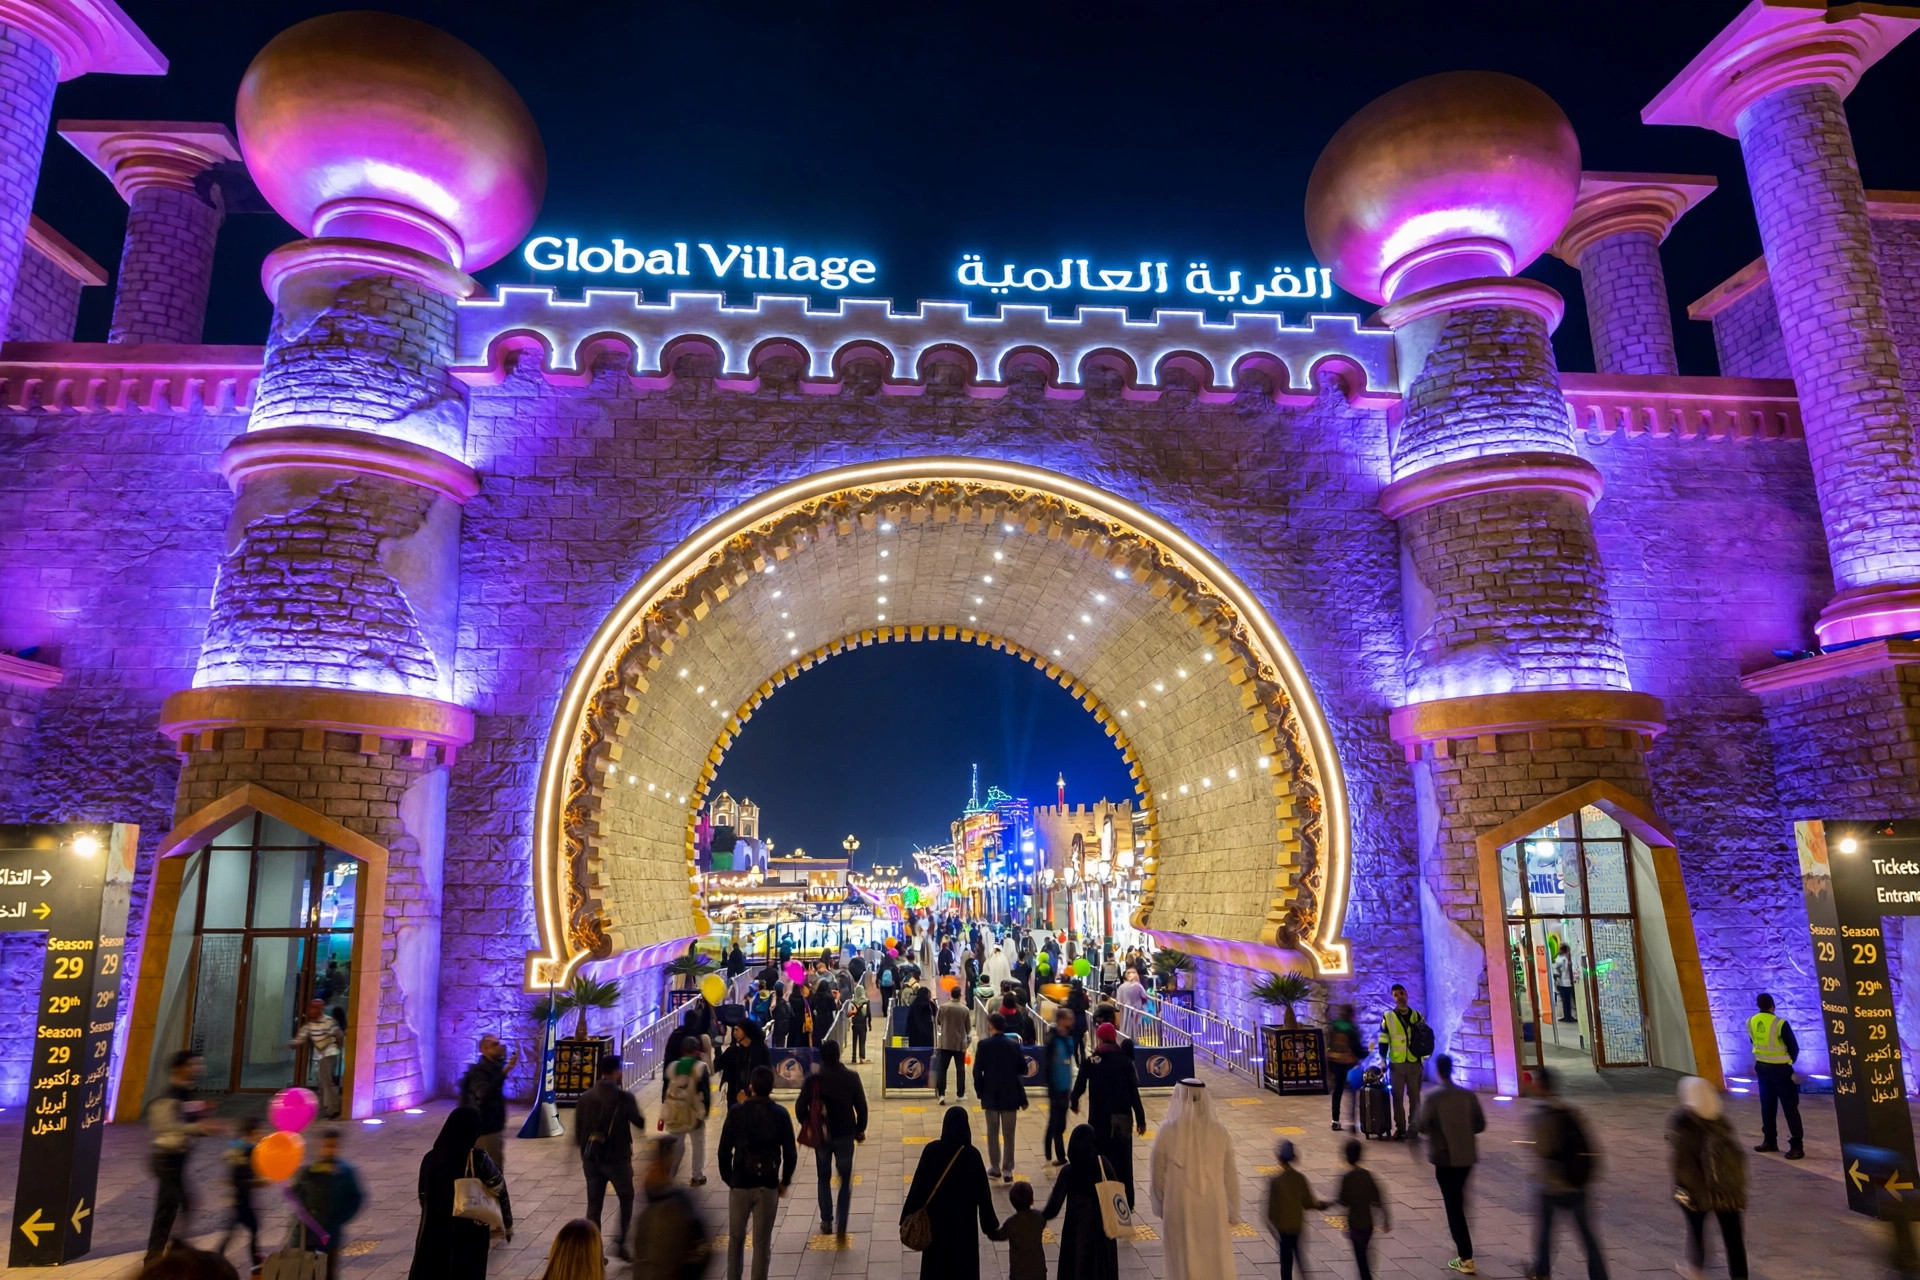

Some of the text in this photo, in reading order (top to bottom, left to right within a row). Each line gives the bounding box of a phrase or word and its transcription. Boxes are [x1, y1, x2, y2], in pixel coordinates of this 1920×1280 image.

[524, 236, 876, 290] Global Village
[957, 253, 1333, 304] القرية العالمية
[1872, 857, 1920, 875] Tickets
[1809, 923, 1836, 936] Season
[1841, 925, 1880, 937] Season
[48, 937, 93, 950] Season
[99, 935, 124, 947] Season
[1817, 942, 1835, 962] 29
[1851, 943, 1877, 964] 29
[53, 957, 84, 979] 29
[101, 954, 119, 975] 29
[1821, 976, 1840, 992] 29th
[1856, 980, 1882, 996] 29th
[48, 996, 81, 1013] 29th
[1822, 1000, 1848, 1014] Season
[1854, 1006, 1892, 1018] Season
[38, 1025, 82, 1038] Season
[89, 1021, 114, 1034] Season
[1832, 1020, 1845, 1034] 29
[1868, 1024, 1887, 1040] 29
[47, 1046, 71, 1064] 29
[94, 1040, 107, 1058] 29
[1870, 1064, 1895, 1084] أبريل
[36, 1091, 67, 1114] أبريل
